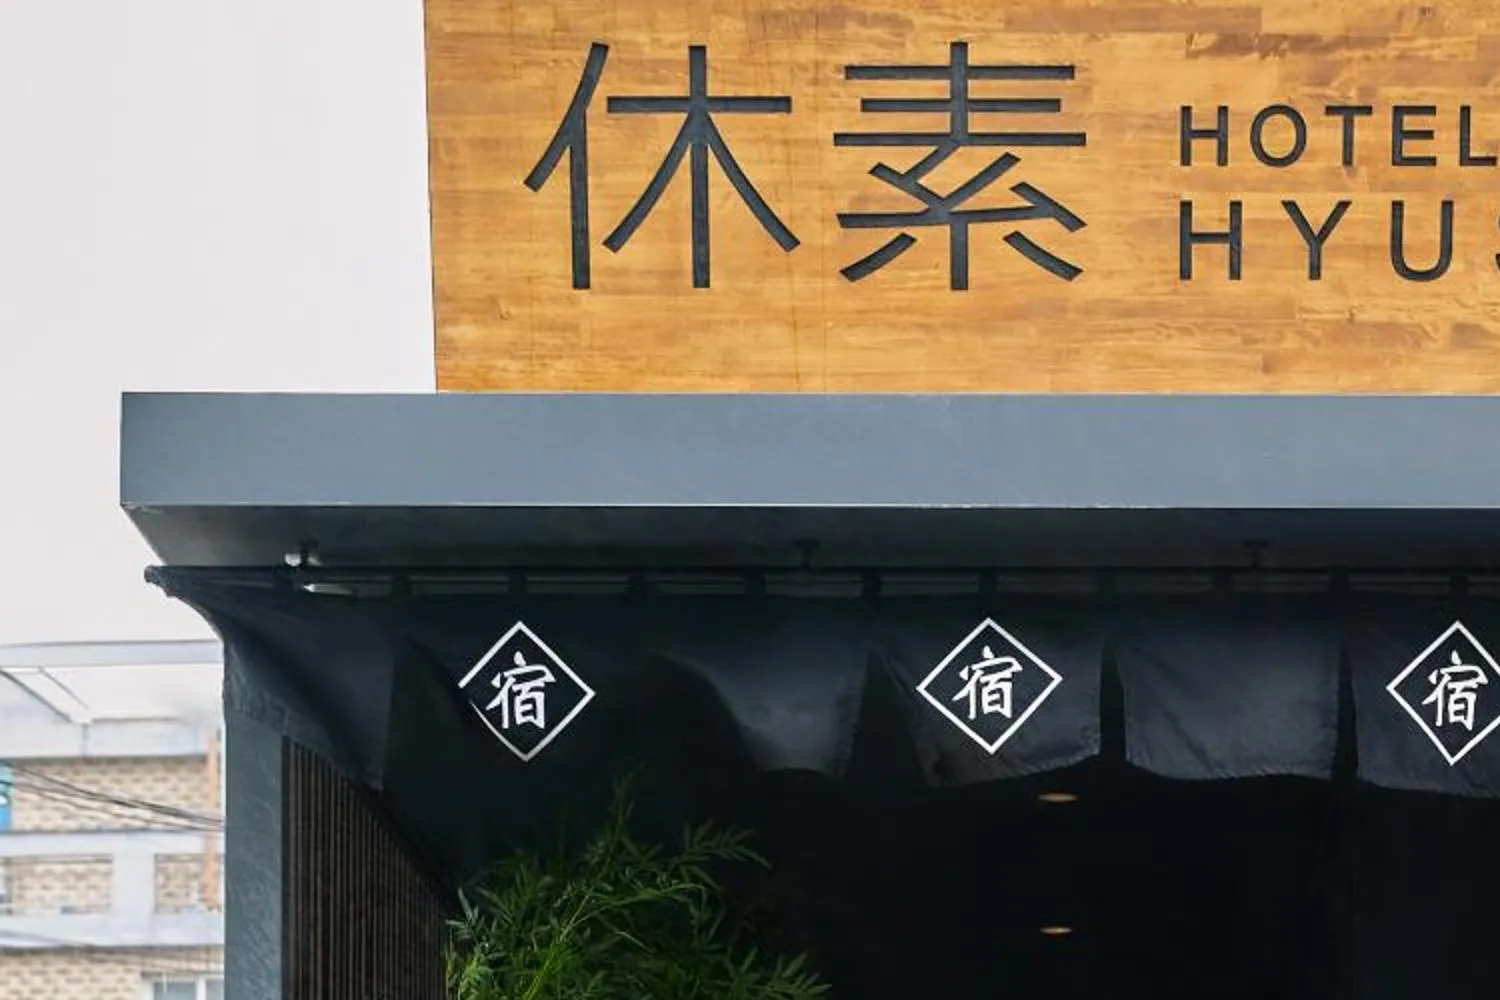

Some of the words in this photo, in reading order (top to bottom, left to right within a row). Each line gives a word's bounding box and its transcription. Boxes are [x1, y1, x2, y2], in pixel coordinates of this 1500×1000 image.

[523, 42, 1086, 290] 休素
[1180, 104, 1498, 167] HOTEL
[485, 651, 556, 730] 宿
[951, 645, 1023, 720] 宿
[1421, 650, 1489, 731] 宿
